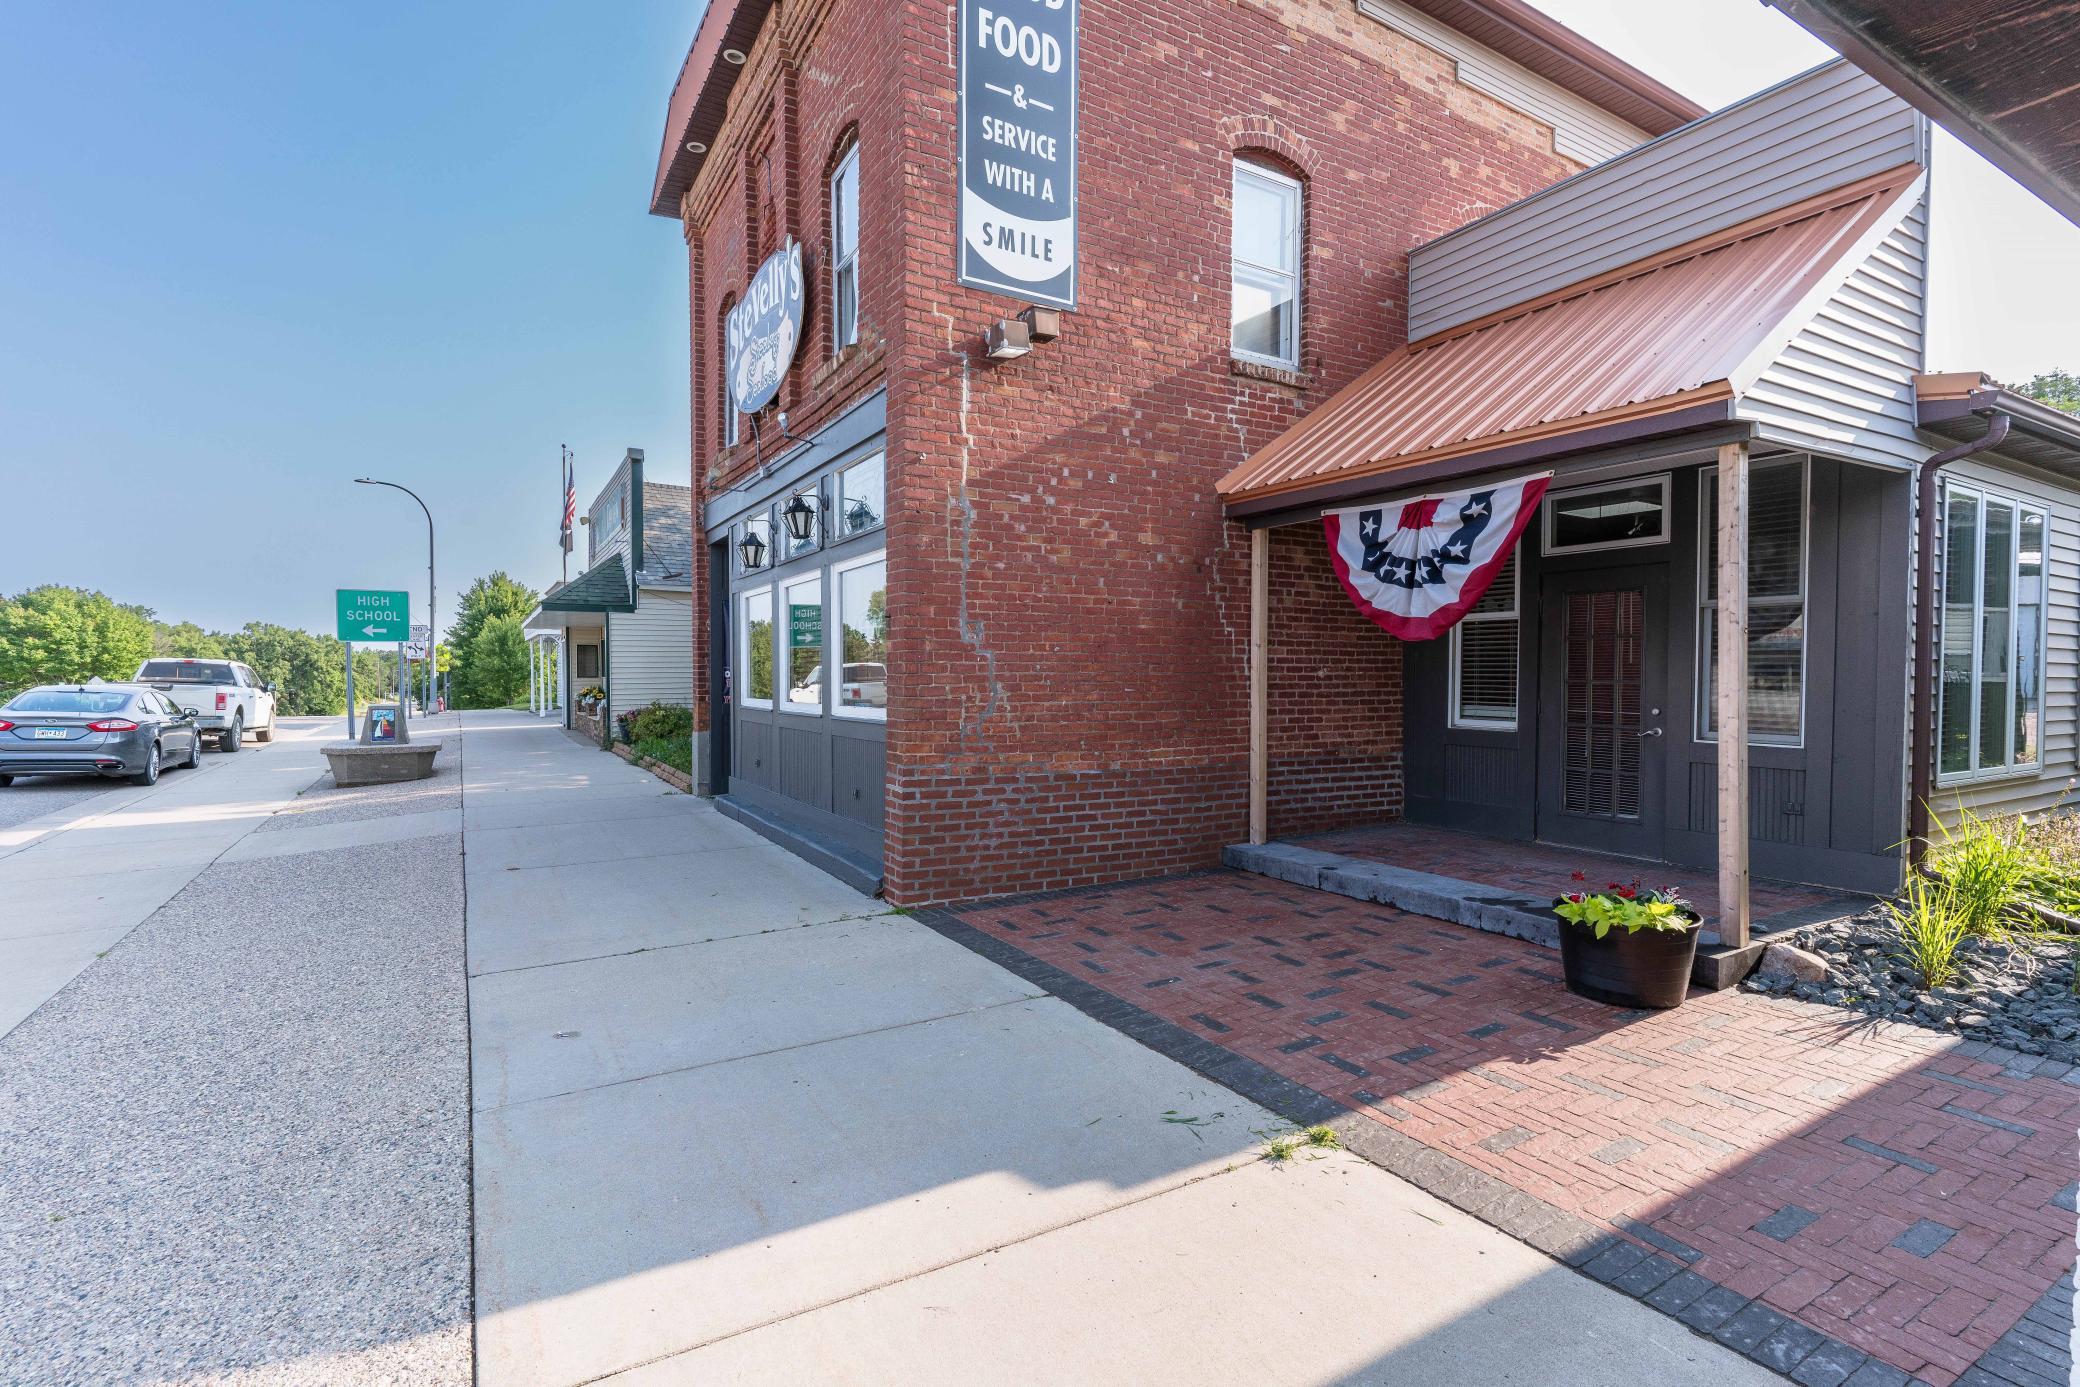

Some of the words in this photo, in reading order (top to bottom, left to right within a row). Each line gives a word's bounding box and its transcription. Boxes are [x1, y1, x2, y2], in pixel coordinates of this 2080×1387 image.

[978, 7, 1061, 73] FOOD
[1012, 84, 1027, 110] &
[982, 115, 1056, 162] SERVICE
[984, 159, 1035, 196] WITH
[1041, 178, 1054, 203] A
[982, 222, 1053, 262] SMILE
[346, 610, 401, 621] SCHOOL
[357, 595, 390, 607] HIGH
